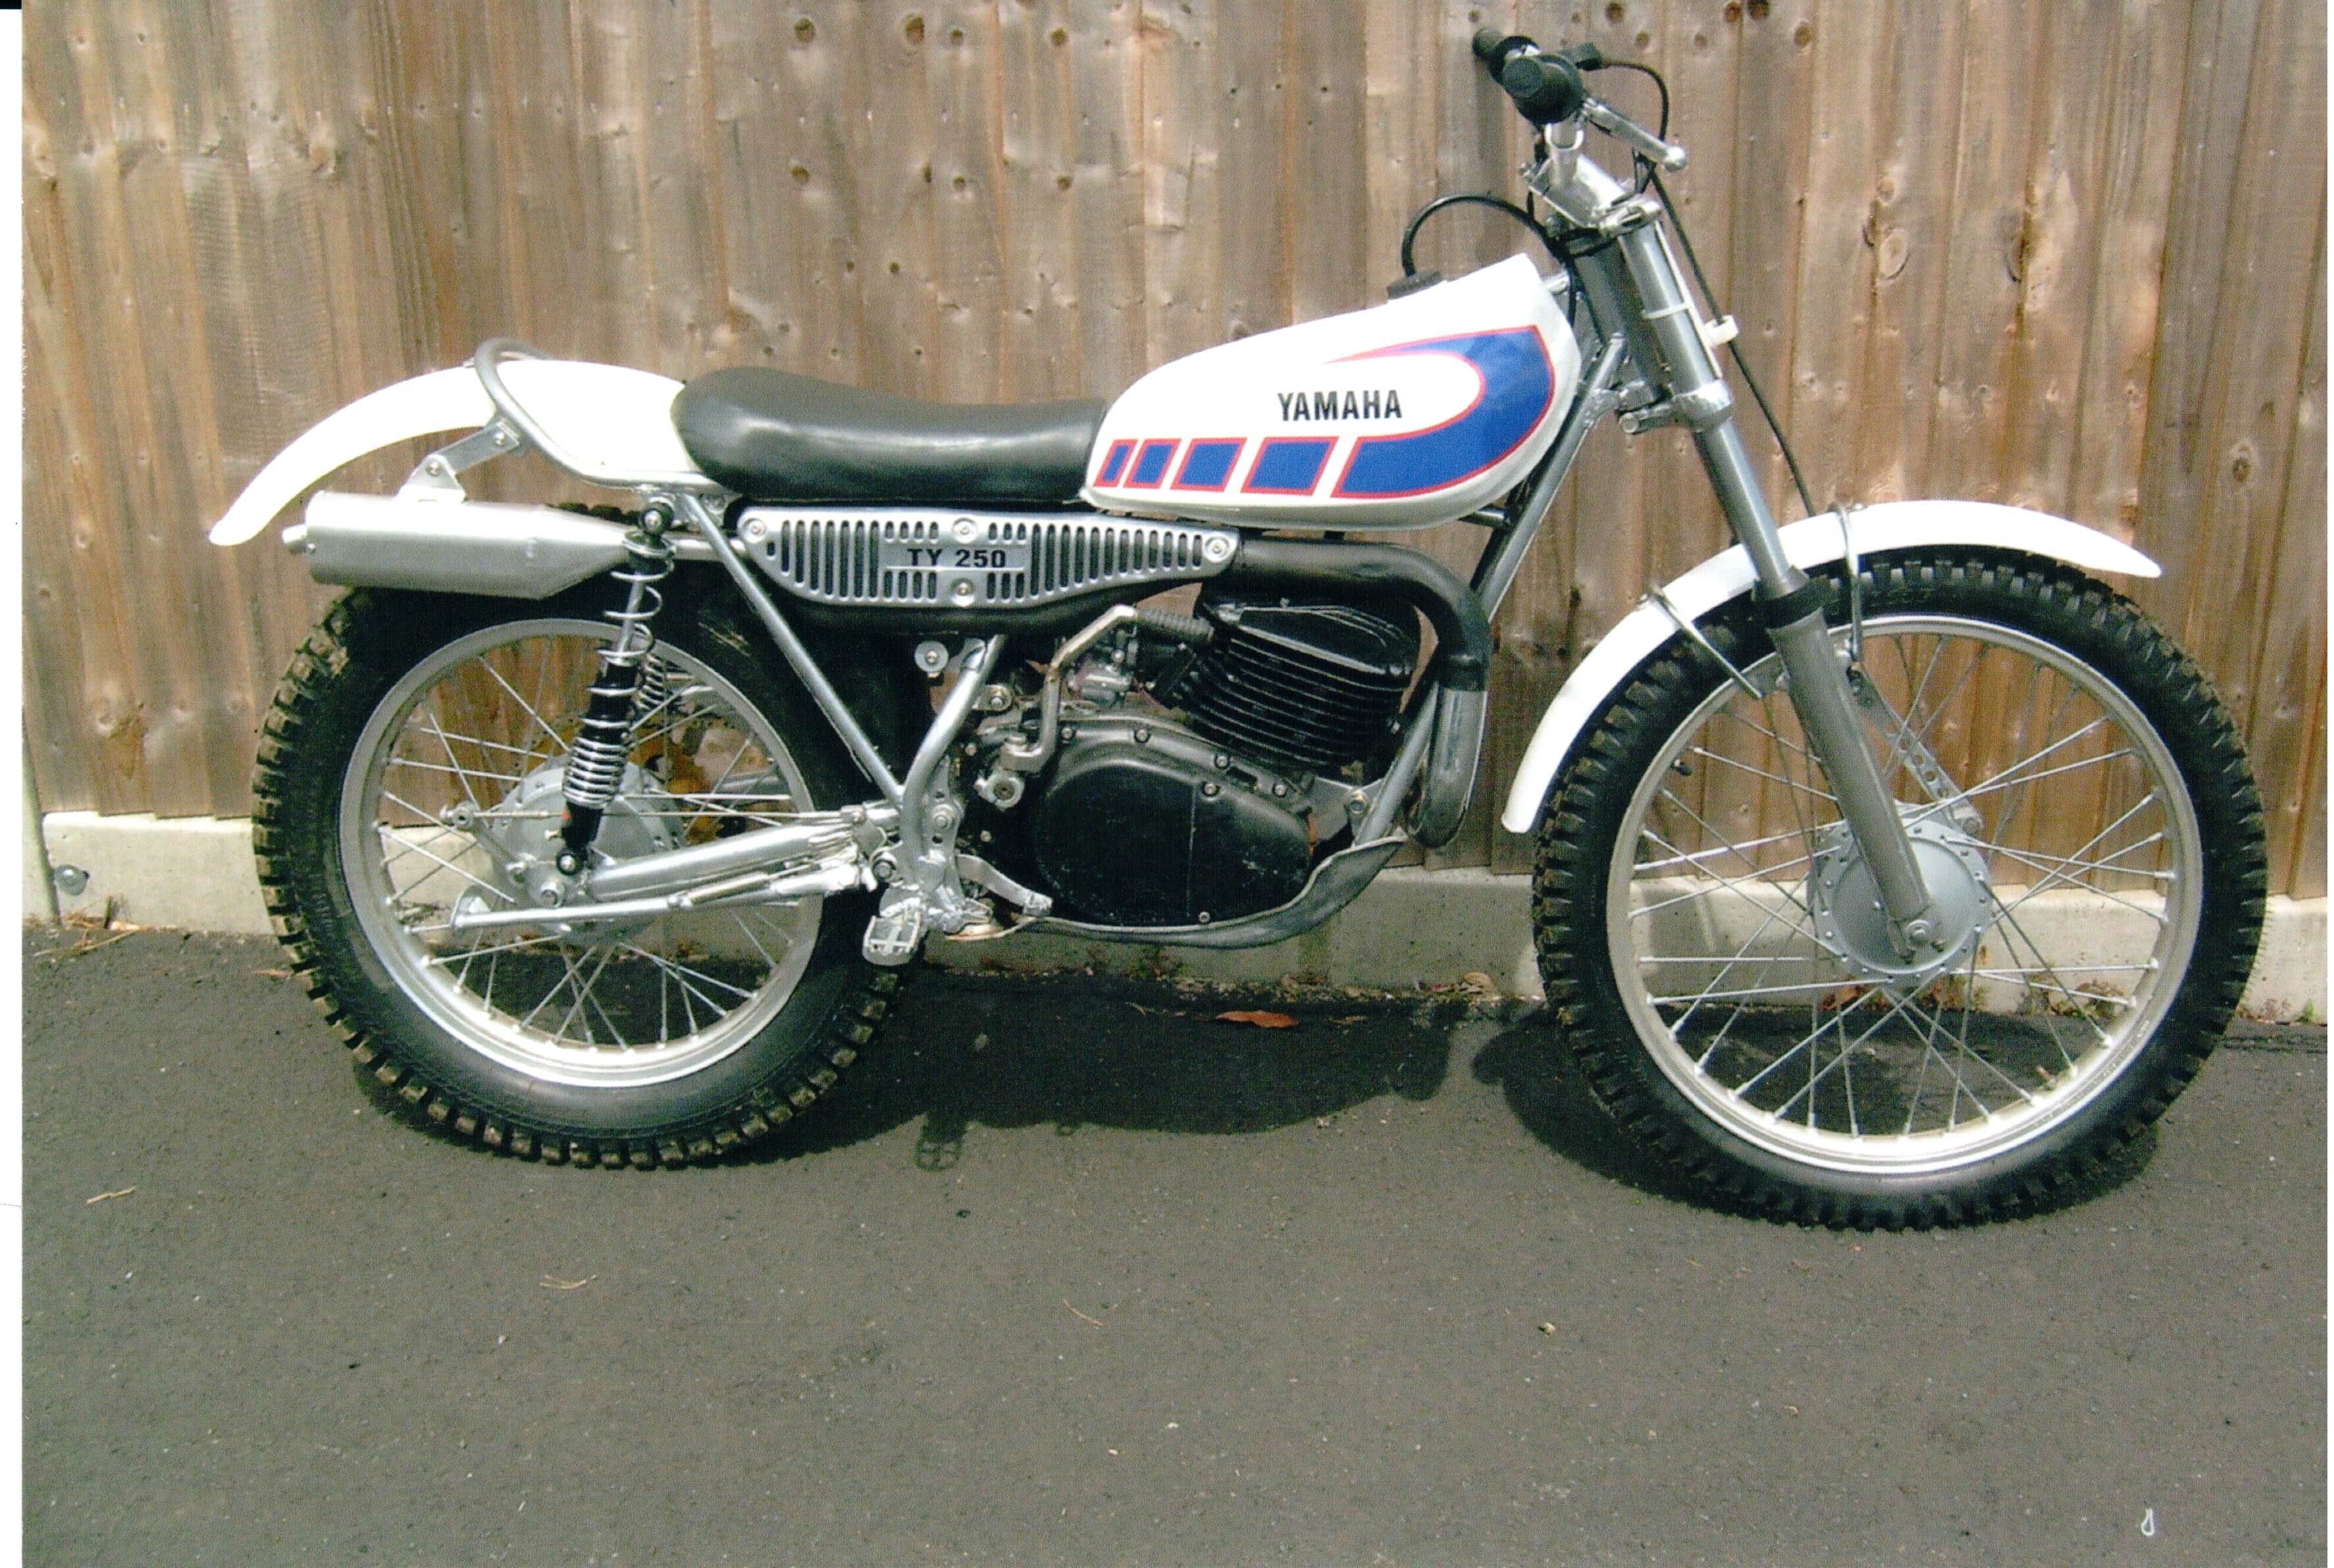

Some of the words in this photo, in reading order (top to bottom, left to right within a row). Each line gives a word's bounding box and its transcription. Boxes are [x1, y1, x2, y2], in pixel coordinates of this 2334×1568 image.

[1278, 390, 1402, 421] YAMAHA
[907, 548, 943, 566] TY
[955, 548, 1006, 568] 250
